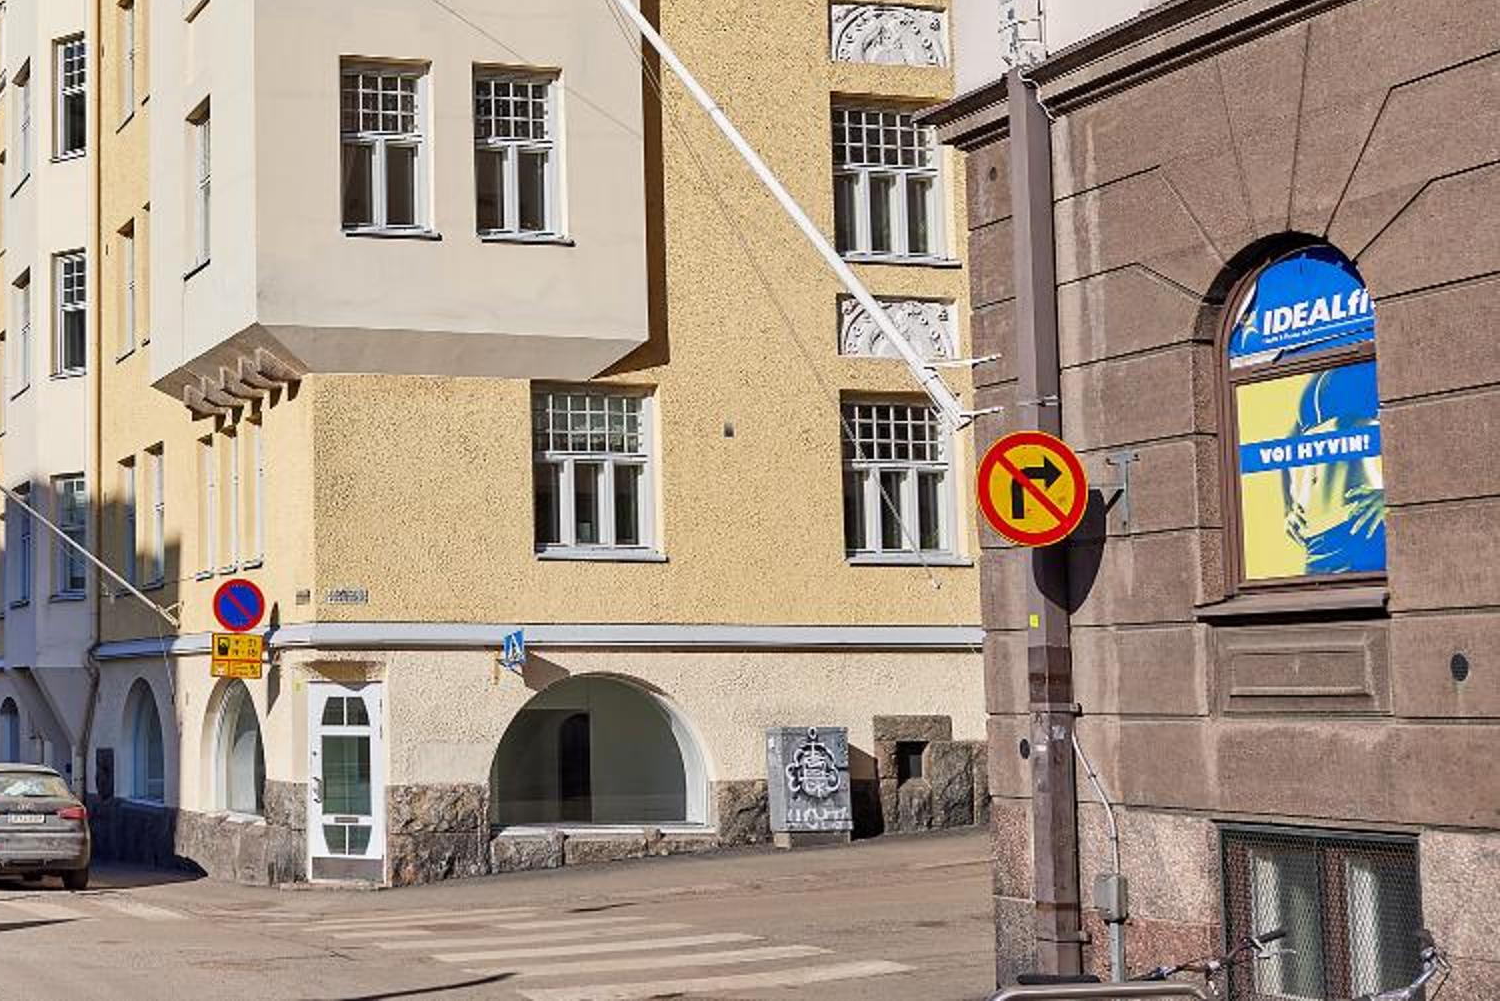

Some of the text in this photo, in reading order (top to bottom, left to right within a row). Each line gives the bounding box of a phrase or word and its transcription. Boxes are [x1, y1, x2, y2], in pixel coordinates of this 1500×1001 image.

[1263, 288, 1376, 335] IDEALfi
[1260, 434, 1370, 463] VOI HYVIN!
